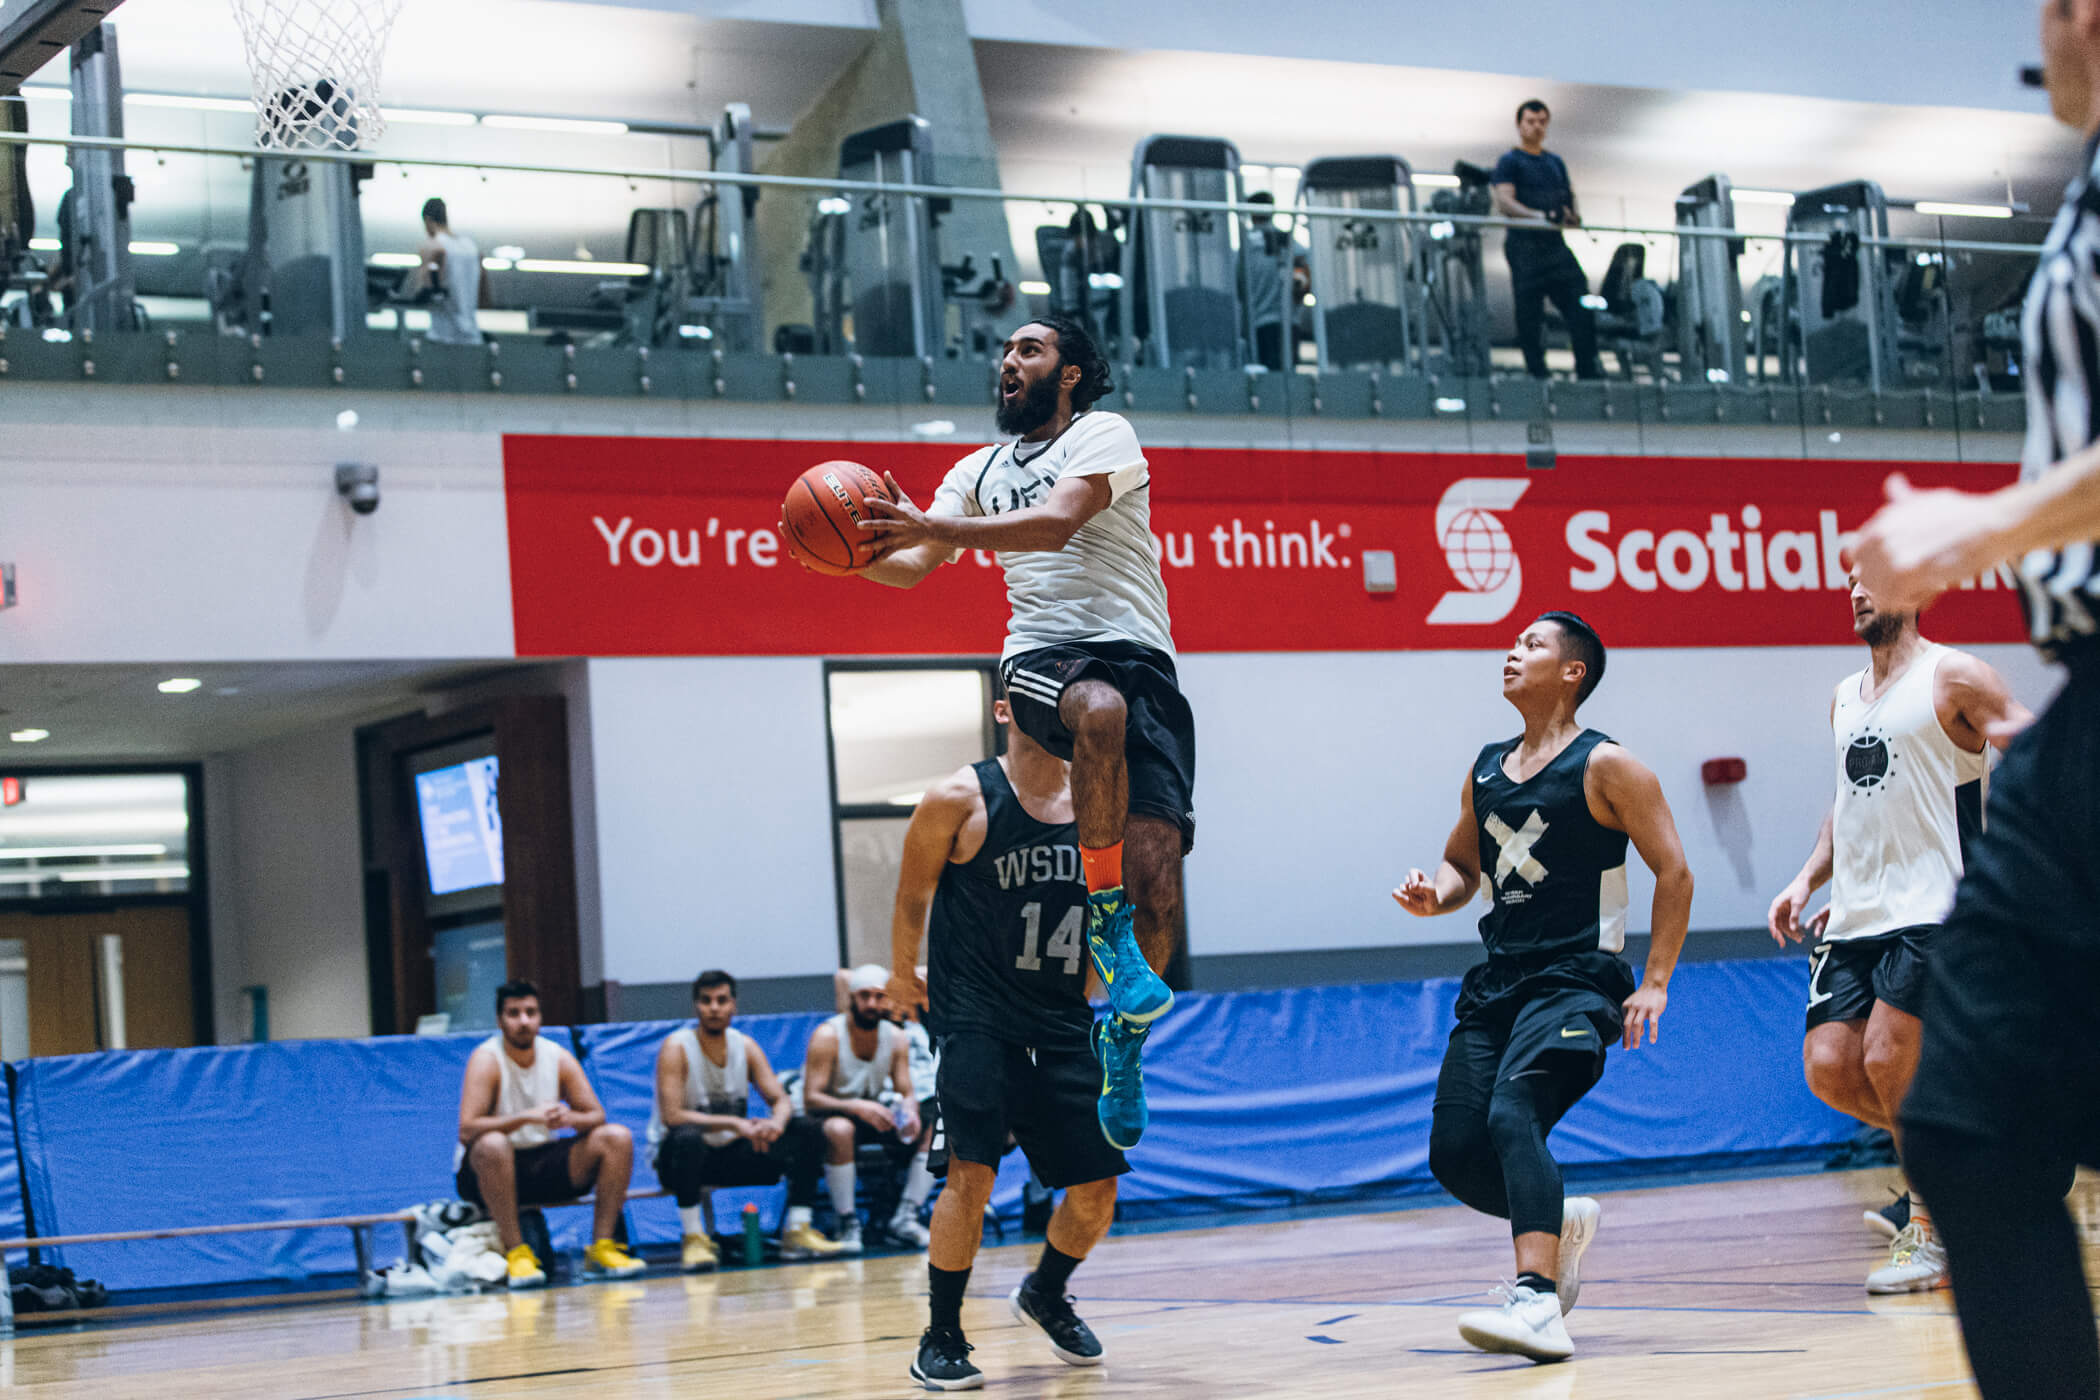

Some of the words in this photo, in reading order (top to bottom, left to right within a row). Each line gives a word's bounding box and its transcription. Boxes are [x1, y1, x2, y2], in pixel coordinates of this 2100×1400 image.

[593, 516, 779, 567] You're
[1565, 504, 2018, 592] Scotiab
[1015, 901, 1084, 975] 14
